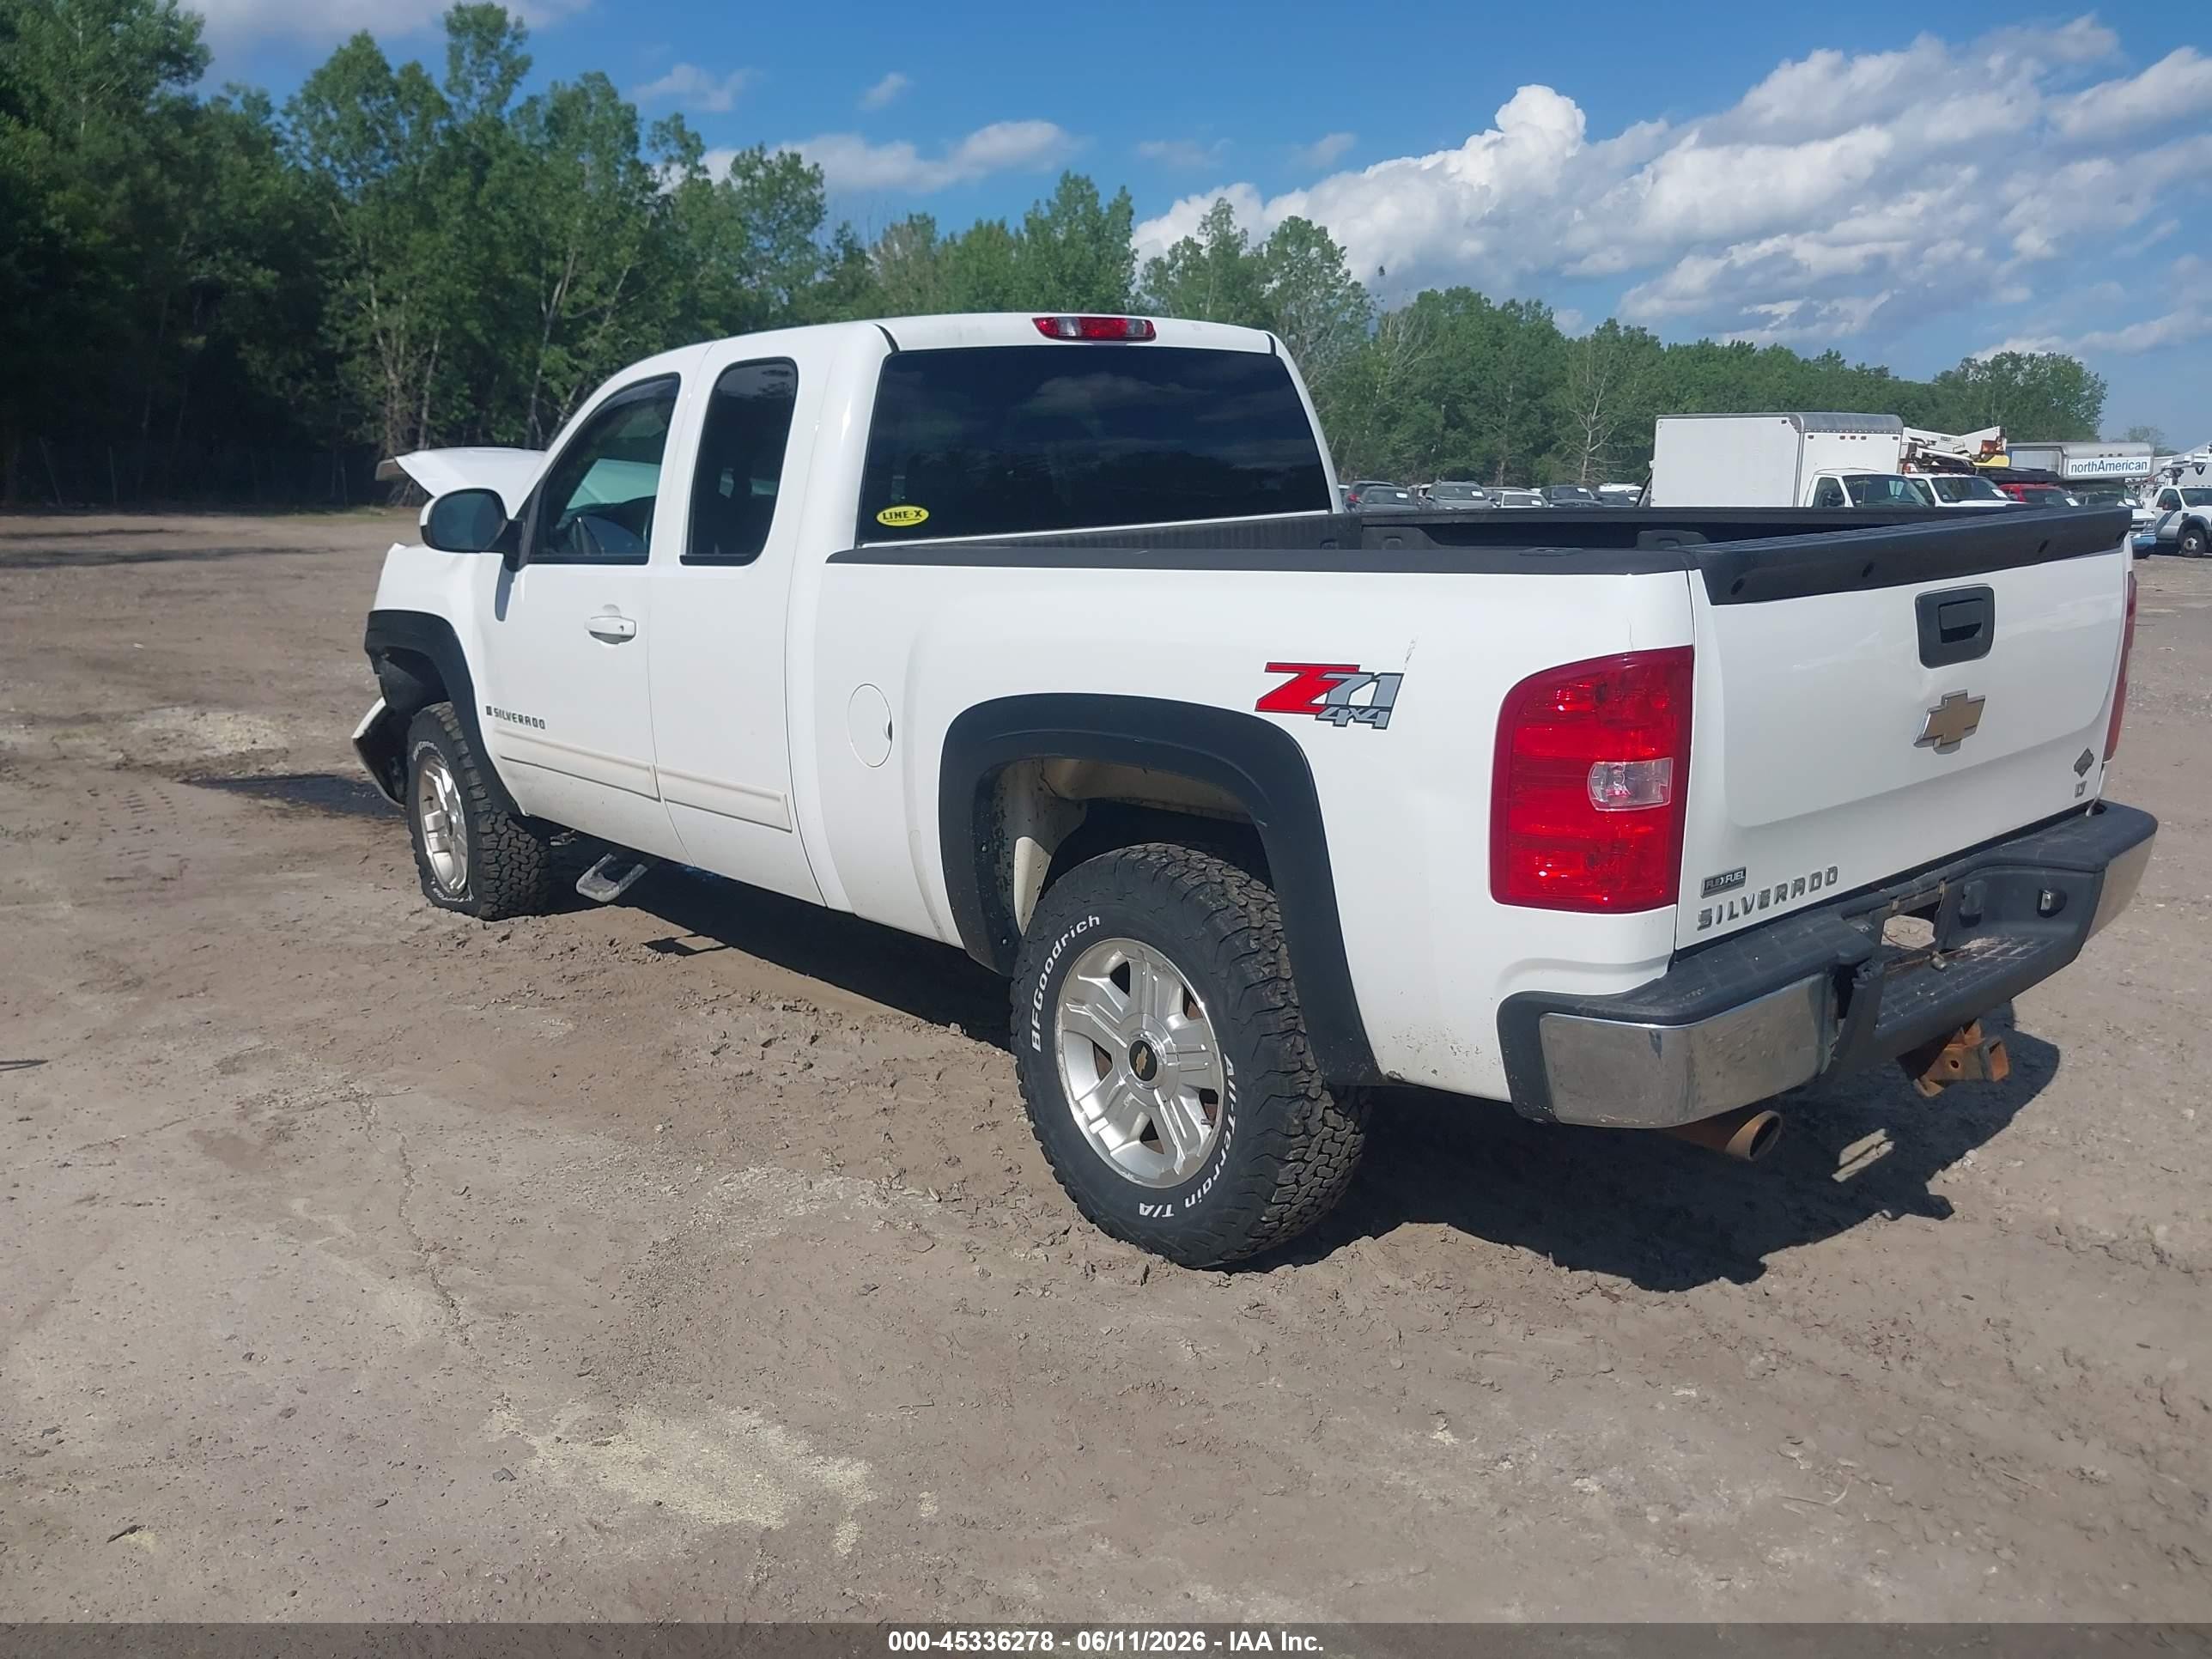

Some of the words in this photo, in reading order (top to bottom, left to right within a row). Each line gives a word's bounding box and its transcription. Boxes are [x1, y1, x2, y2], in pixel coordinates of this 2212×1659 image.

[2070, 459, 2148, 473] northAmerican
[882, 509, 923, 520] LINE-X
[1255, 661, 1405, 715] Z71
[493, 707, 546, 730] SILVERADO
[1697, 866, 1838, 932] SILVERADO
[1030, 914, 1101, 1053] BFGoodrich
[1139, 1202, 1175, 1218] T/A
